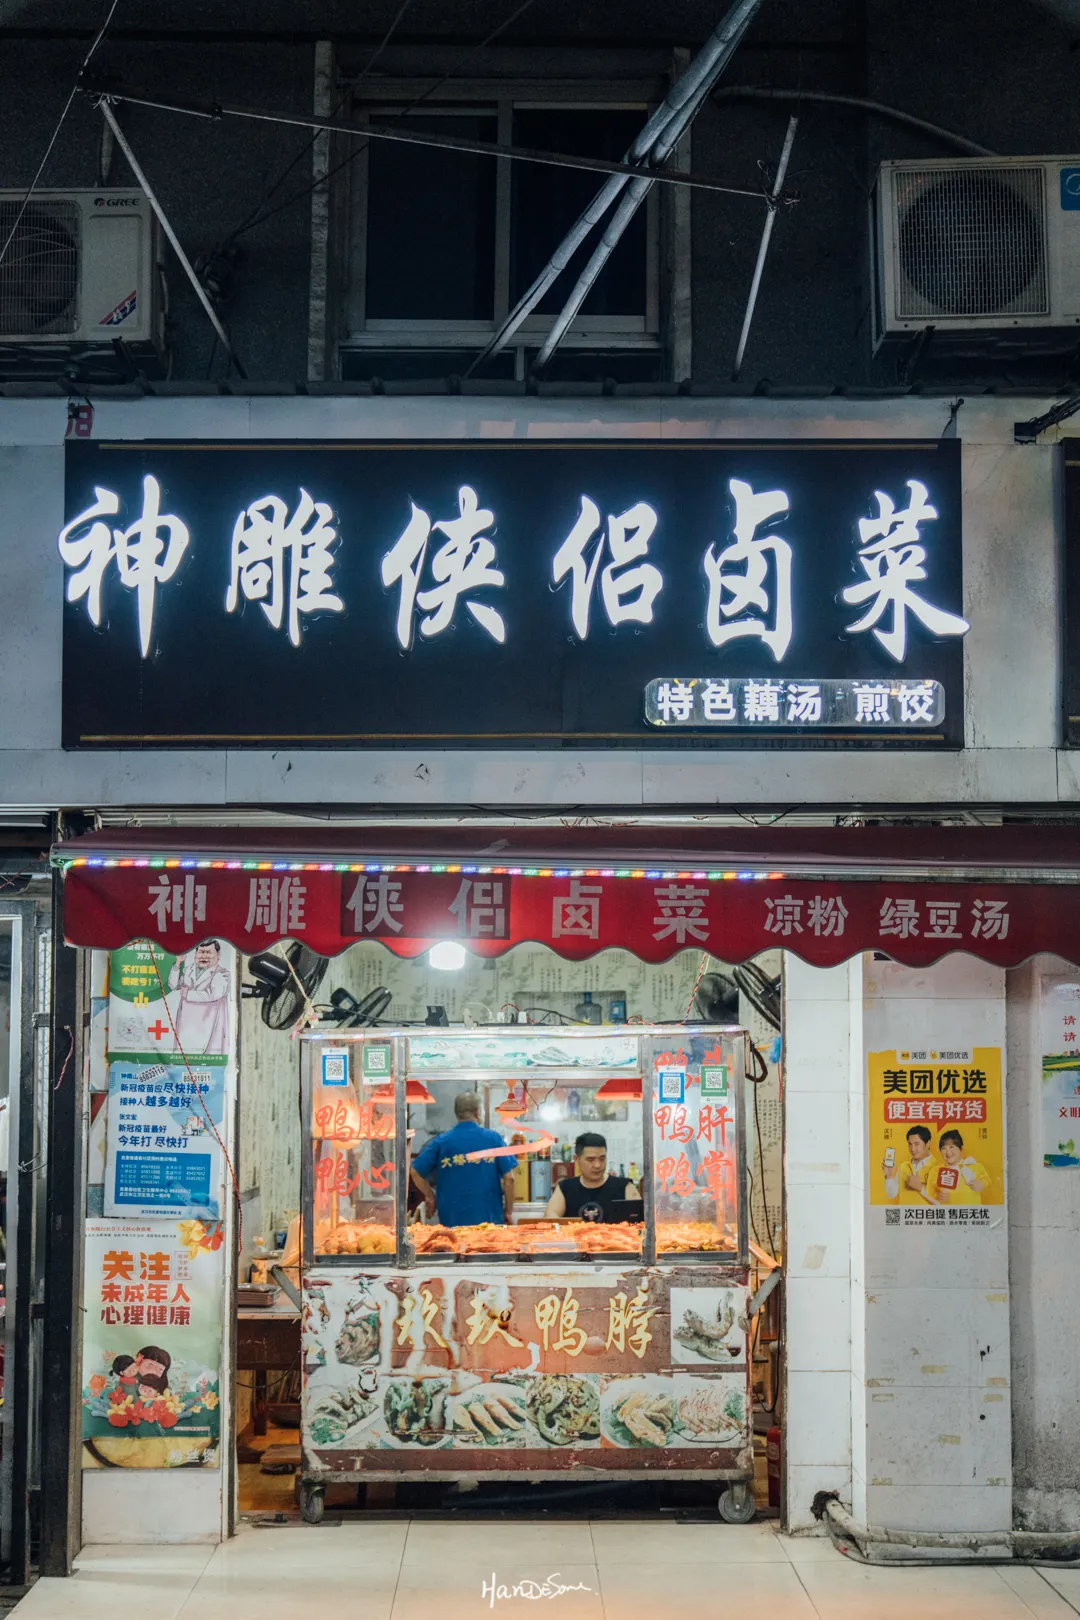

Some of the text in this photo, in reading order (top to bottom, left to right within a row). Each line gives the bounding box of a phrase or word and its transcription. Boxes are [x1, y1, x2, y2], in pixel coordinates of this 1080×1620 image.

[107, 198, 140, 207] GREE
[58, 474, 971, 663] 神雕侠侣卤菜
[657, 683, 934, 723] 特色藕汤 煎饺
[148, 873, 1010, 943] 神雕侠侣卤菜 凉粉 绿豆汤
[1062, 1015, 1077, 1026] 请
[1063, 1032, 1077, 1042] 请
[911, 1052, 969, 1060] 美团 美团优选
[120, 1082, 210, 1094] 新冠疫苗应尽快接种
[883, 1069, 987, 1094] 美团优选
[120, 1095, 192, 1108] 接种人越多越好
[888, 1100, 983, 1119] 便宜有好货
[118, 1124, 167, 1133] 新冠疫苗最好
[653, 1104, 734, 1147] 鸭肝
[118, 1135, 189, 1148] 今年打 尽快打
[315, 1152, 395, 1196] 鸭心
[655, 1150, 733, 1200] 鸭掌
[939, 1170, 957, 1187] 省
[904, 1209, 990, 1219] 次日自提 售后无忧
[103, 1250, 170, 1280] 关注
[100, 1283, 191, 1303] 未成年人
[100, 1305, 191, 1325] 心理健康
